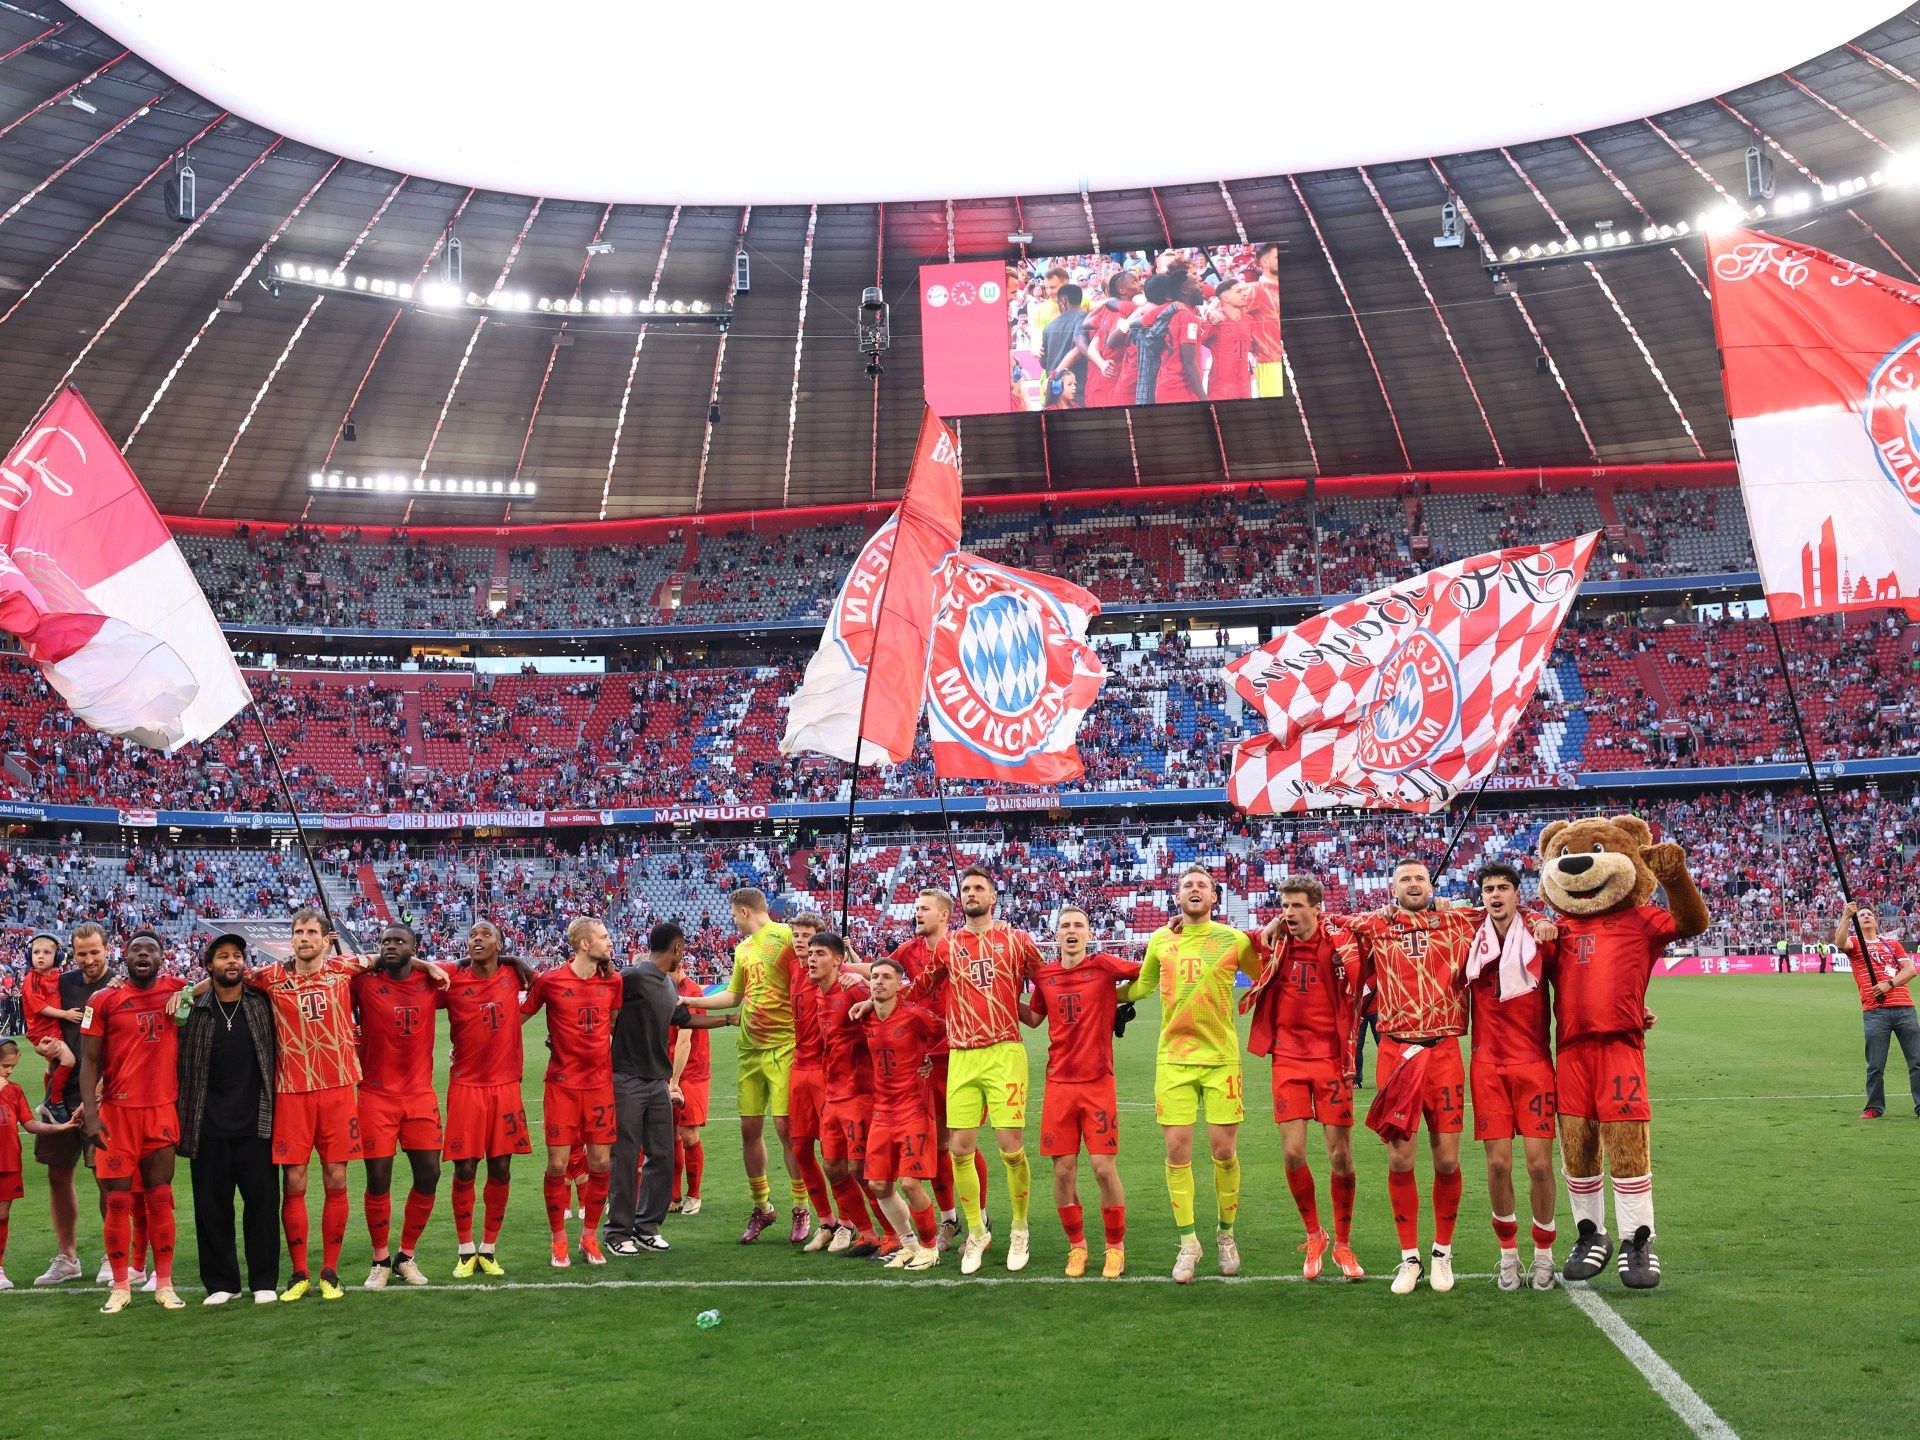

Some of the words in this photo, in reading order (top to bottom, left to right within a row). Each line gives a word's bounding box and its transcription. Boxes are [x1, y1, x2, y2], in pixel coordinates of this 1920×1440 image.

[1800, 766, 1831, 775] Alanz
[14, 806, 45, 815] Investors
[223, 815, 251, 824] Allianz
[264, 816, 290, 824] Global
[405, 815, 424, 827] RED
[427, 814, 458, 827] BULLS
[461, 813, 529, 826] TAUBENBACH
[655, 805, 766, 822] MAINBURG
[970, 958, 994, 989] T
[1180, 957, 1202, 984] T
[300, 991, 328, 1022] T
[480, 1000, 505, 1031] T
[1057, 993, 1082, 1024] T
[136, 1011, 164, 1042] T
[394, 1006, 420, 1036] T
[577, 1006, 601, 1036] T
[877, 1048, 897, 1077] T
[1612, 1075, 1641, 1101] 12
[1529, 1094, 1555, 1117] 45
[349, 1117, 359, 1139] 8
[904, 1133, 928, 1157] 17
